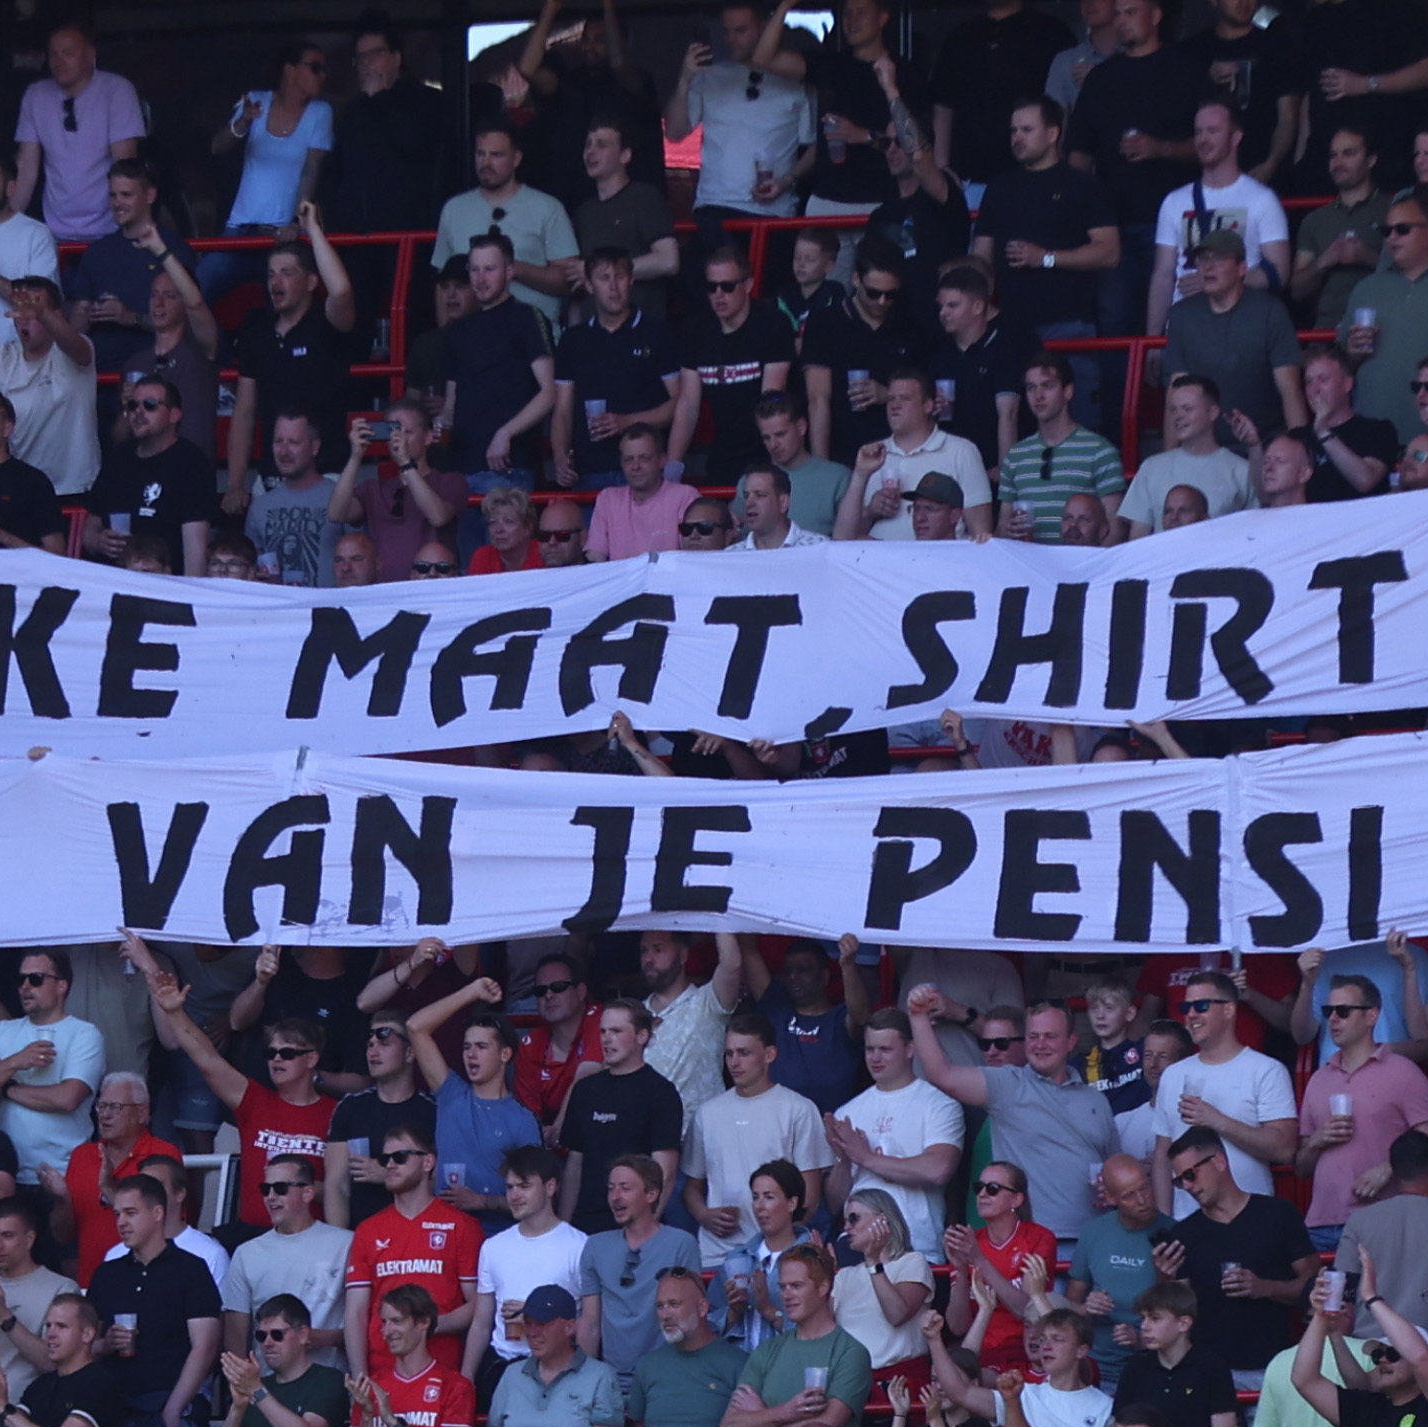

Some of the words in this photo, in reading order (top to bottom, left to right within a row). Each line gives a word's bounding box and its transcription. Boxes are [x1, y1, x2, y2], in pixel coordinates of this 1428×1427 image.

[887, 551, 1409, 710] SHIRT
[107, 793, 457, 943] VAN
[563, 804, 751, 936] JE
[376, 1259, 443, 1279] ELEKTRAMAT
[1109, 1254, 1147, 1267] DAILY
